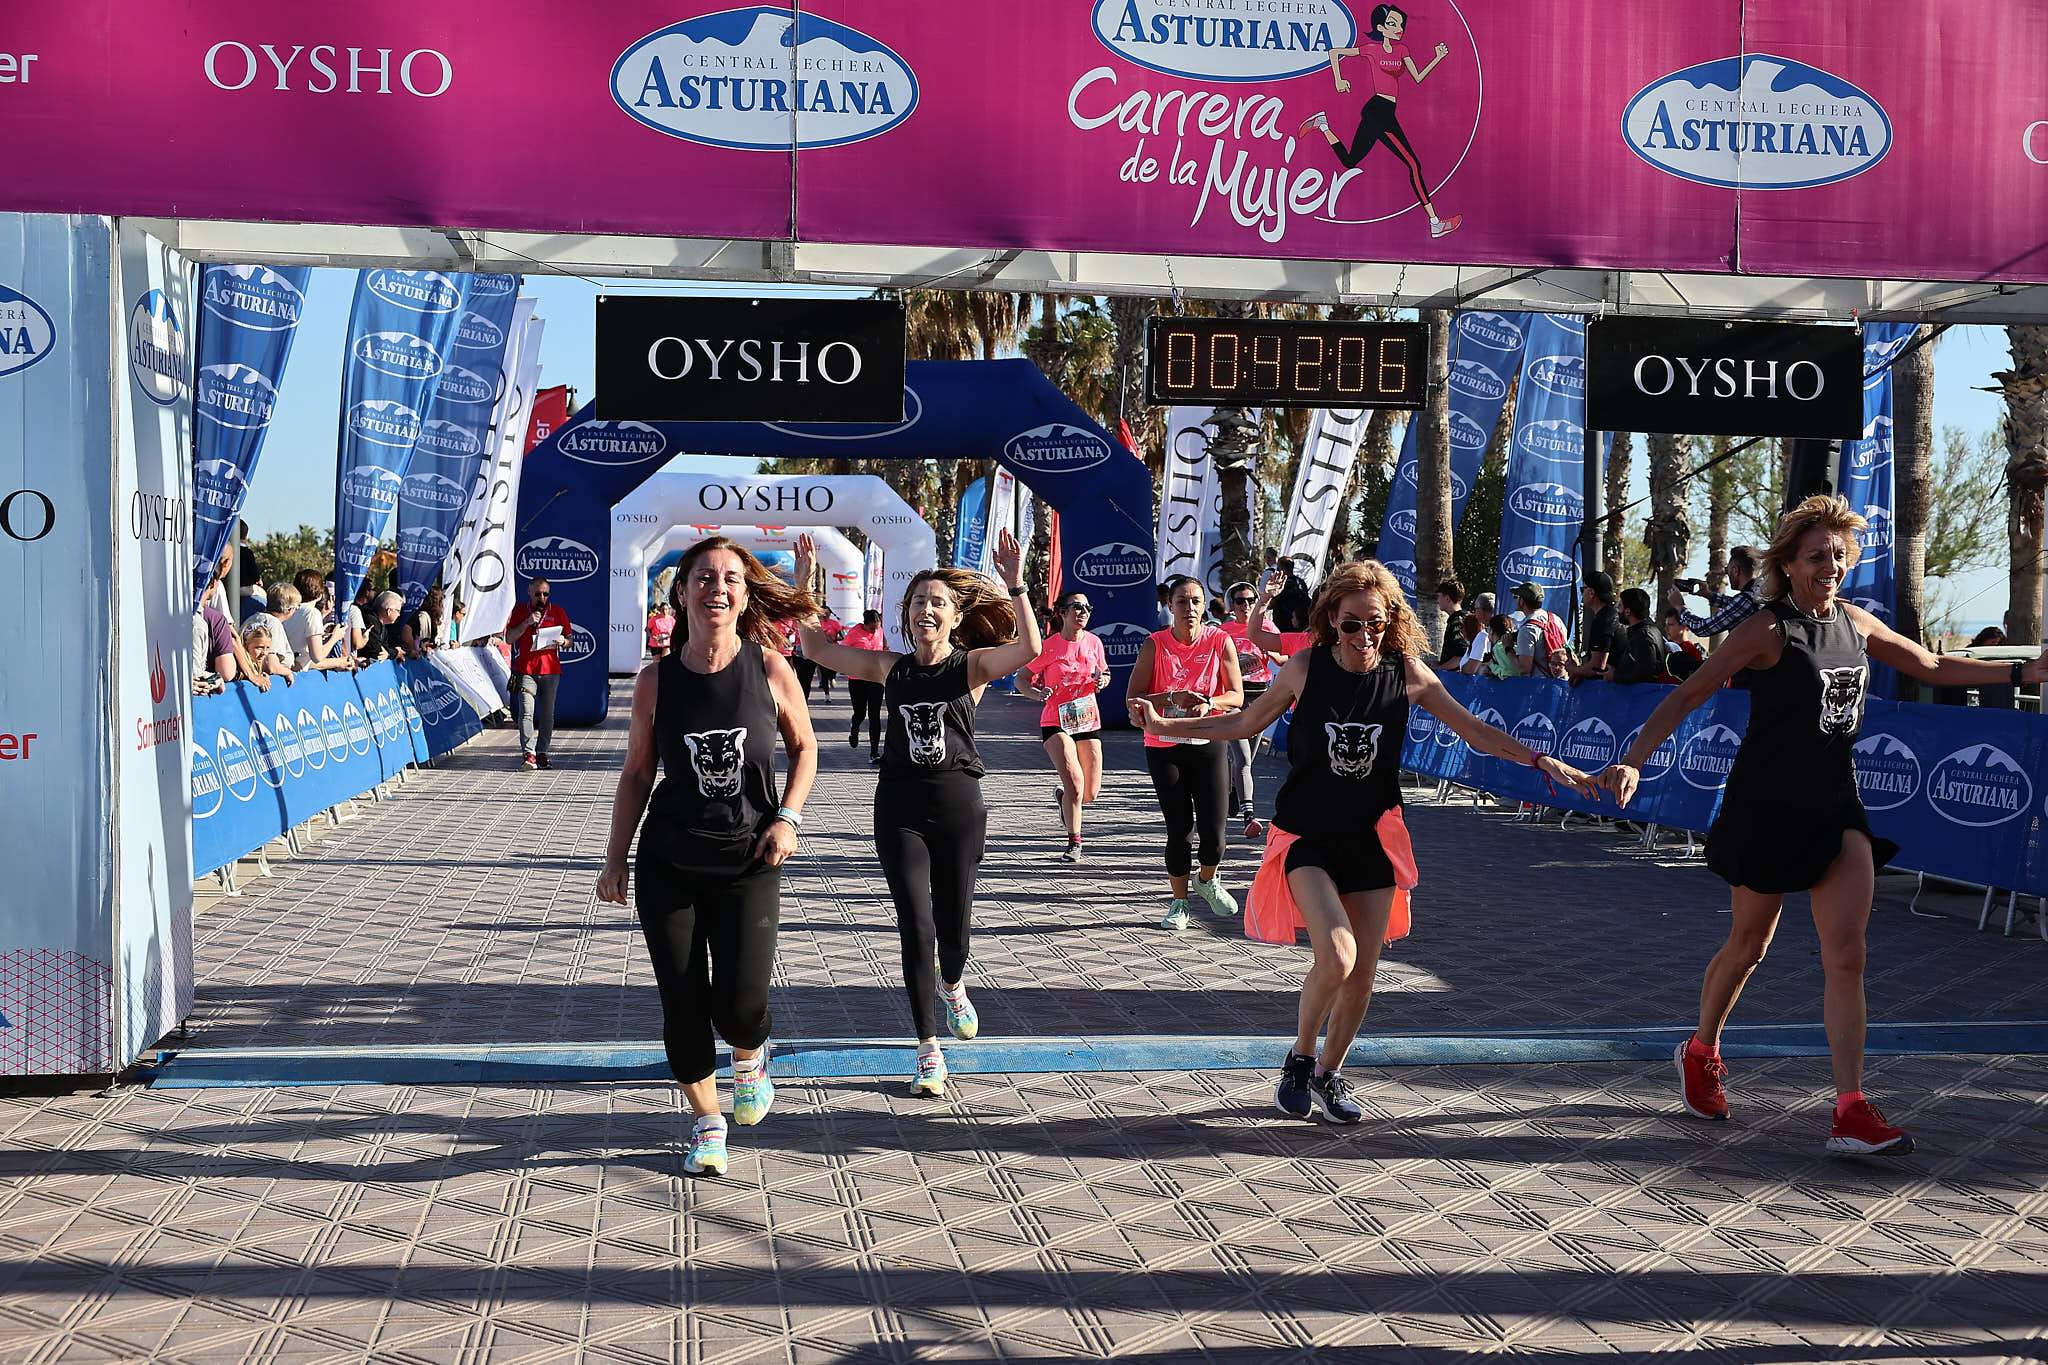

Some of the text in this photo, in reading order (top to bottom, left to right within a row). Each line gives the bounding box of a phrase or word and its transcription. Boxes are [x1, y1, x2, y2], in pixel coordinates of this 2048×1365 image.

[1111, 0, 1334, 52] ASTURIANA
[1245, 1, 1329, 15] LECHERA
[203, 40, 453, 98] OYSHO
[682, 53, 781, 70] CENTRAL
[635, 55, 896, 115] ASTURIANA
[1067, 66, 1284, 140] Carrera
[1685, 99, 1864, 117] CENTRAL LECHERA
[1642, 100, 1872, 157] ASTURIANA
[1119, 136, 1363, 243] de la Mujer
[204, 276, 297, 322] ASTURIANA
[373, 272, 453, 309] ASTURIANA
[1461, 316, 1518, 348] ASTURIANA
[133, 320, 185, 383] ASTURIANA
[647, 336, 862, 385] OYSHO
[1167, 333, 1408, 393] 00:42:06
[1633, 354, 1825, 401] OYSHO
[563, 432, 658, 454] ASTURIANA
[1013, 443, 1105, 461] ASTURIANA
[131, 490, 186, 544] OYSHO
[698, 484, 834, 513] OYSHO
[1514, 492, 1584, 519] ASTURIANA
[616, 514, 658, 524] OYSHO
[872, 515, 912, 525] OYSHO
[519, 553, 593, 572] ASTURIANA
[1078, 560, 1149, 577] ASTURIANA
[1505, 557, 1573, 581] ASTURIANA
[136, 711, 184, 751] Santander
[1561, 735, 1612, 761] ASTURIANA
[1931, 768, 2020, 811] ASTURIANA
